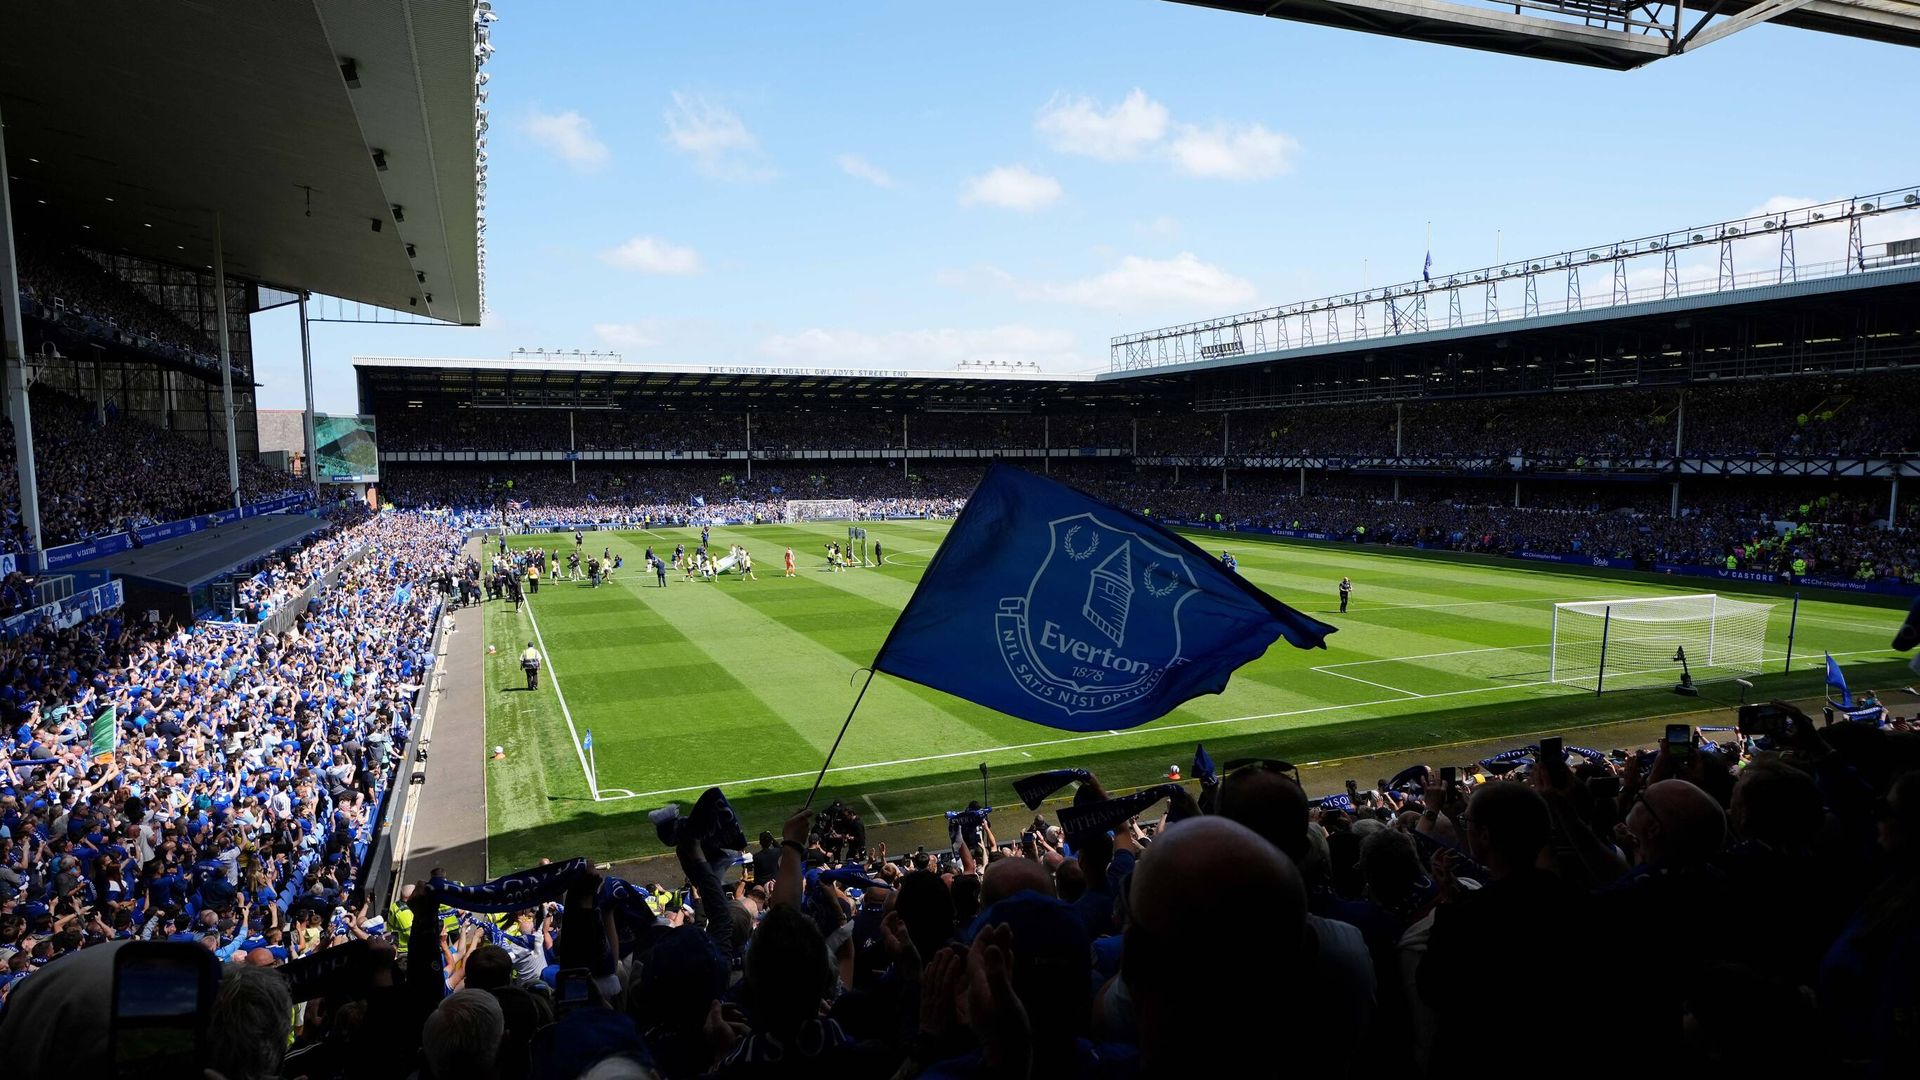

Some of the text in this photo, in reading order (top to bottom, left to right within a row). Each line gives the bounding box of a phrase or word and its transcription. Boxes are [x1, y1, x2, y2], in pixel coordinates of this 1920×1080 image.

[771, 367, 810, 375] KENDALL
[814, 368, 854, 376] GWLADYS
[1731, 571, 1774, 582] CASTORE
[1810, 579, 1867, 590] Chrstopher Ward
[1040, 620, 1150, 674] Everton
[1003, 629, 1020, 661] NIL
[1016, 664, 1055, 697] SATIS
[1057, 690, 1096, 708] NISI
[1072, 666, 1105, 682] 1878
